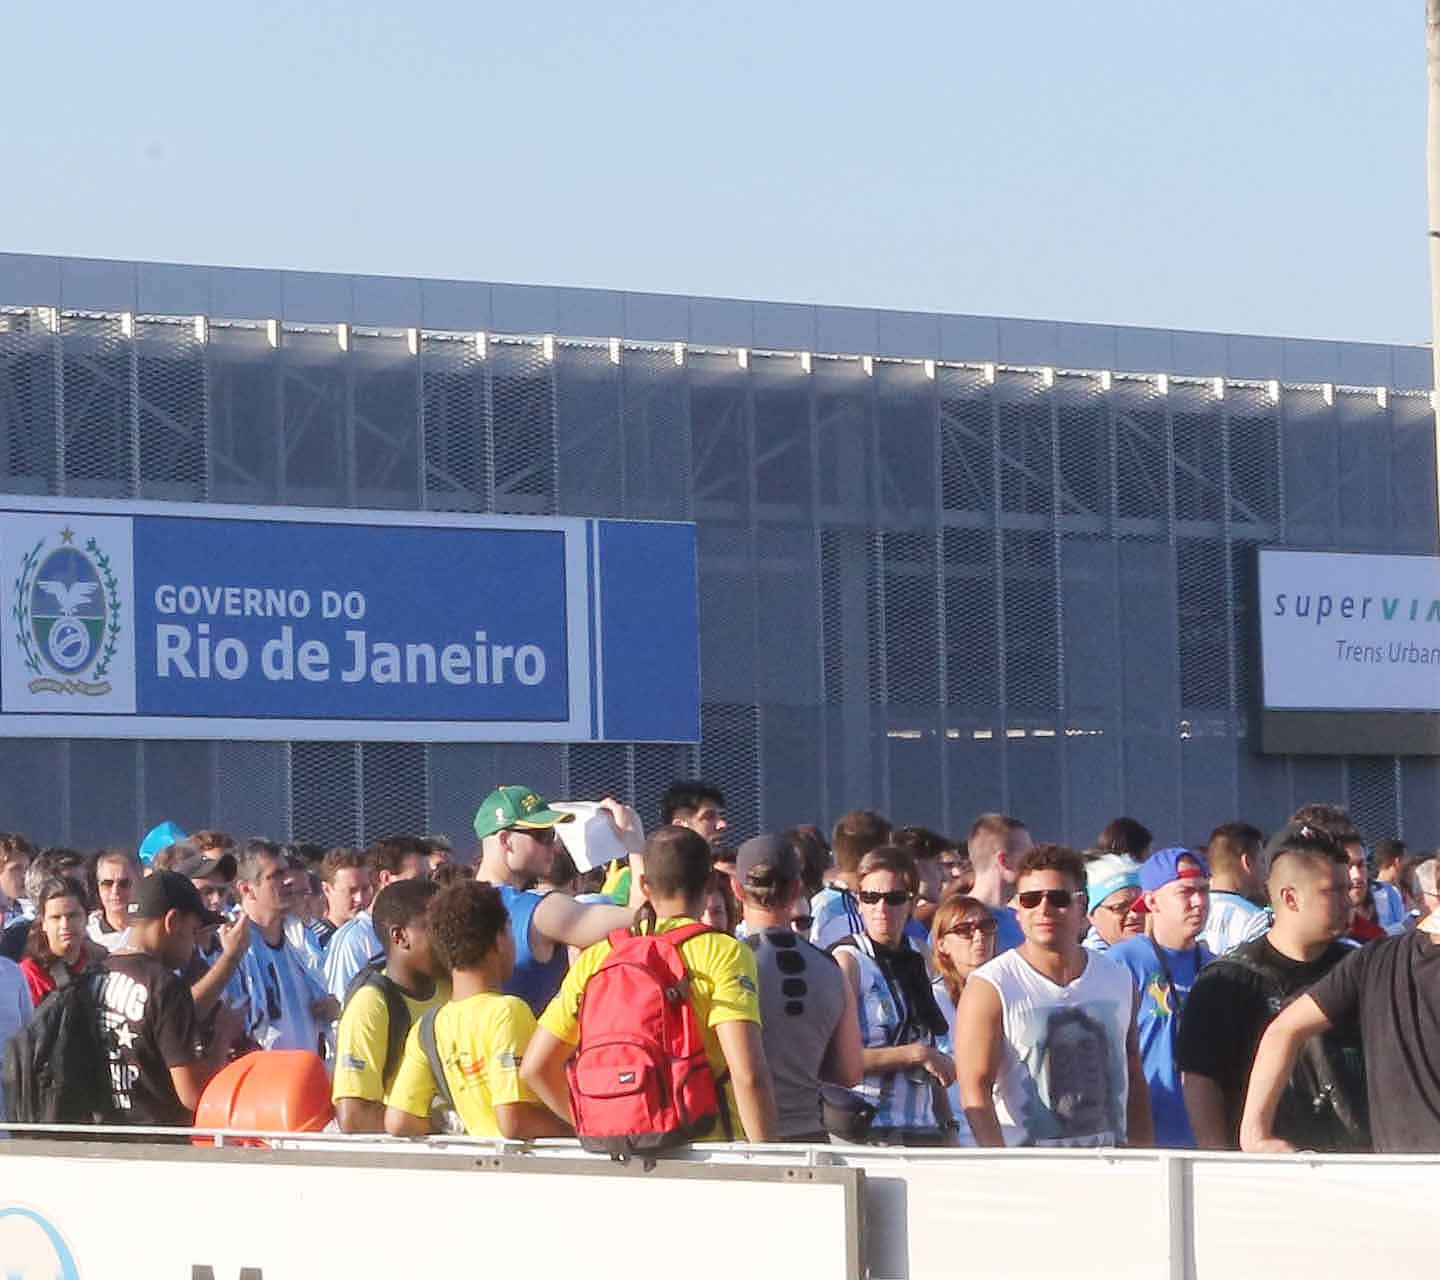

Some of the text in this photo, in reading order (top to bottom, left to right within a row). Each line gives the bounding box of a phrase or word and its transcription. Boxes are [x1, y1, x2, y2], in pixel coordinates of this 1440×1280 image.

[154, 584, 367, 621] GOVERNO DO
[155, 624, 547, 686] Rio de Janeiro
[1335, 640, 1384, 664] Trens
